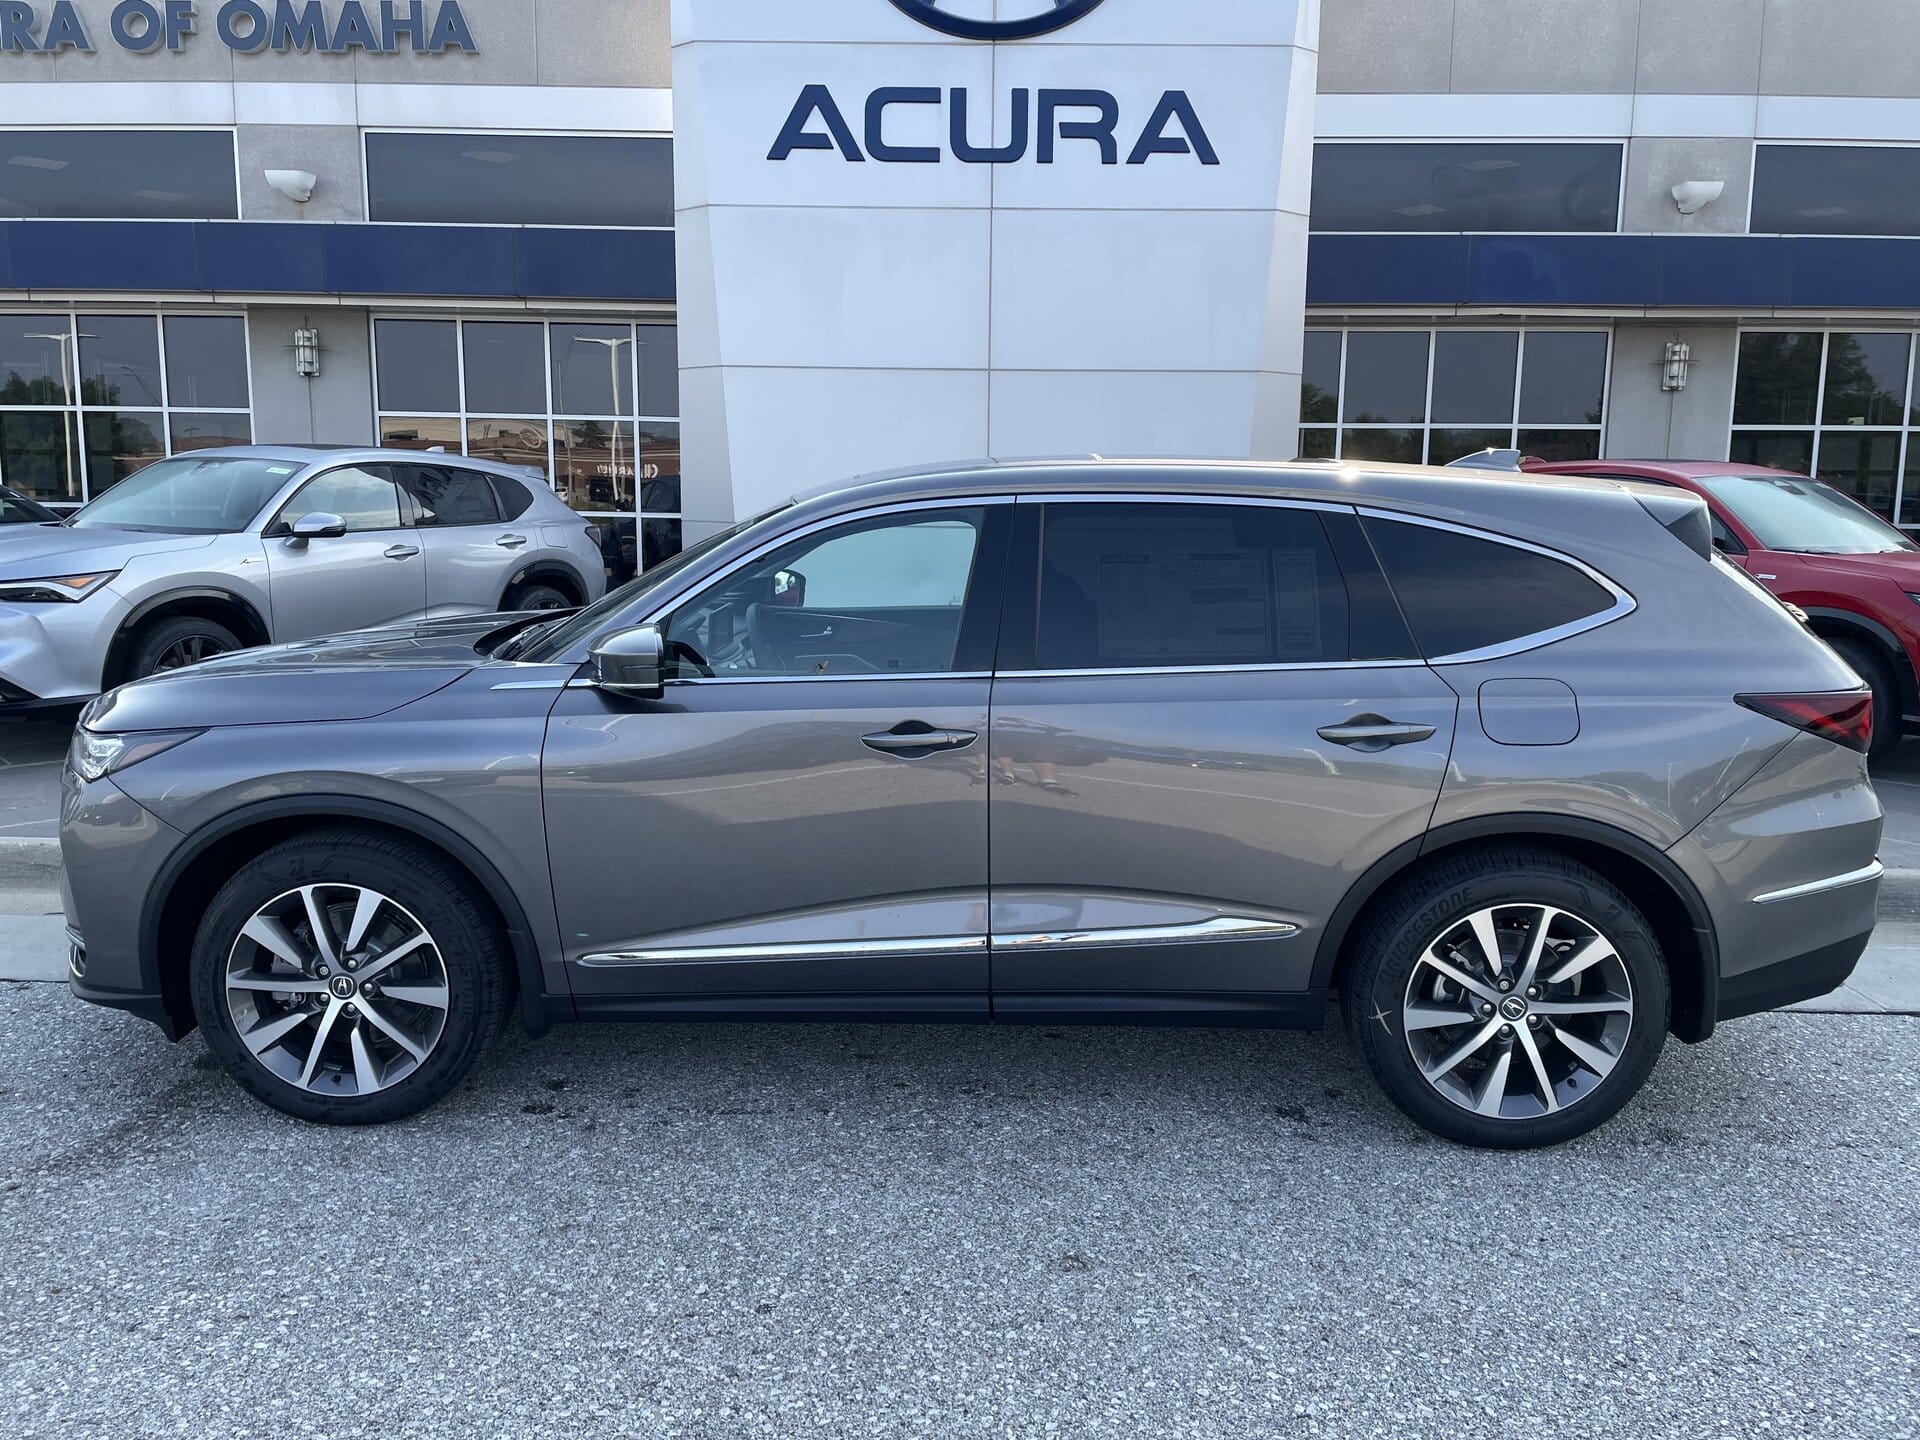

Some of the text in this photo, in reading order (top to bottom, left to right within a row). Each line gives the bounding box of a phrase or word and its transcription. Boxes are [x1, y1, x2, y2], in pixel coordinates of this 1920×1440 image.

[109, 0, 200, 54] OF
[215, 0, 480, 55] OMAHA
[766, 84, 1220, 165] ACURA
